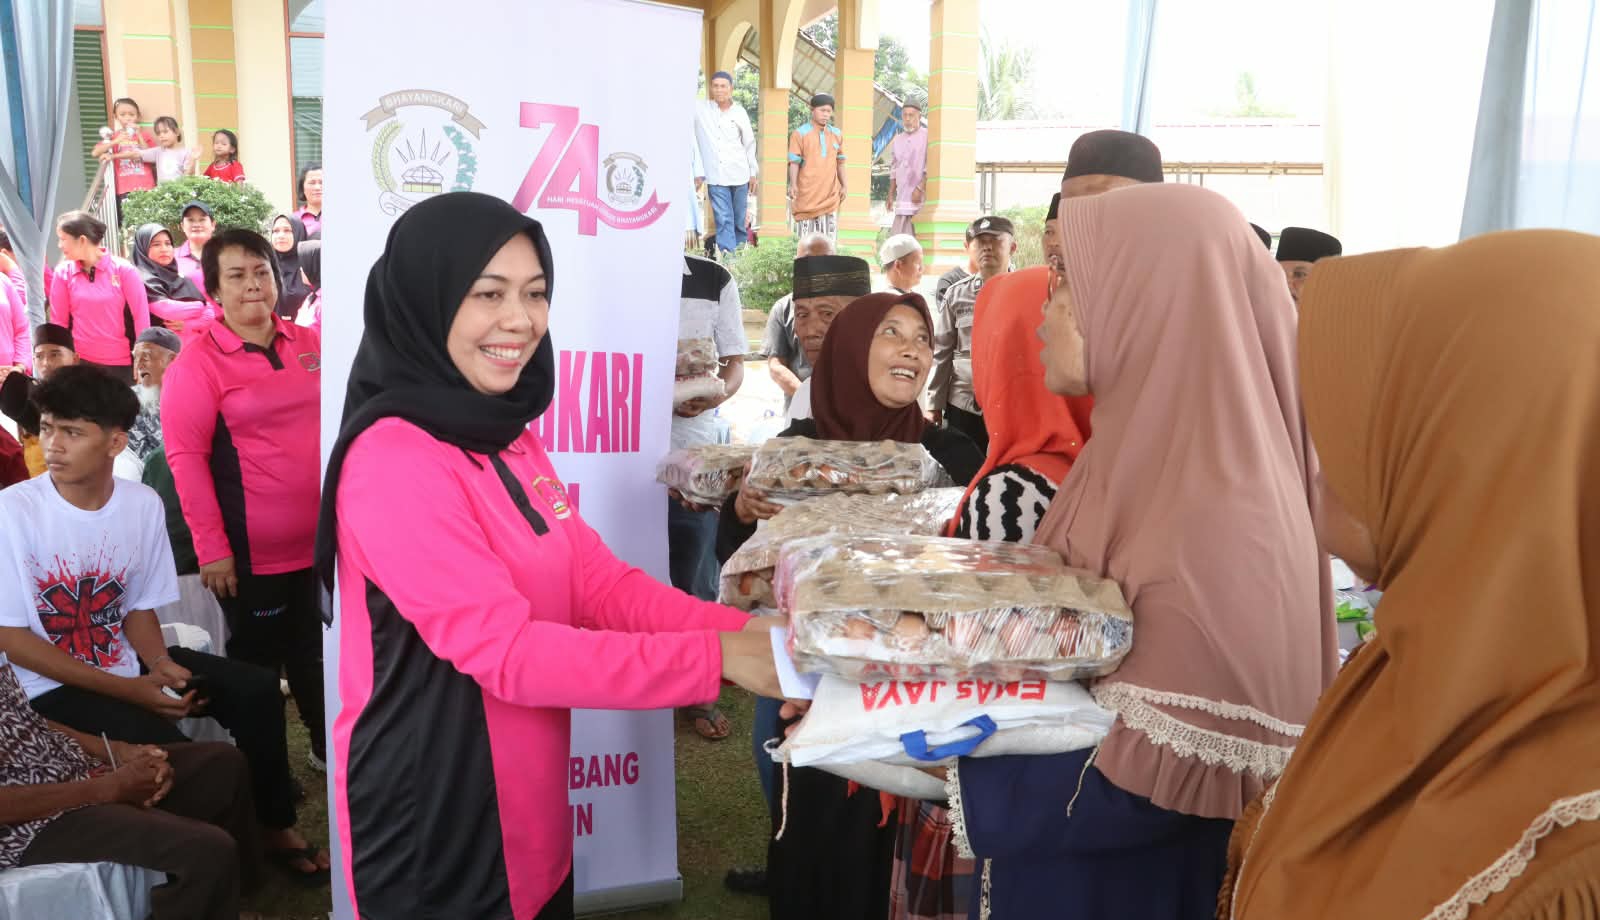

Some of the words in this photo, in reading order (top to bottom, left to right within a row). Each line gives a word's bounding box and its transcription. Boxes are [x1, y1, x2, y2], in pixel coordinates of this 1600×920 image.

[512, 101, 599, 236] 74
[859, 681, 947, 712] JAYA
[569, 751, 640, 790] BANG
